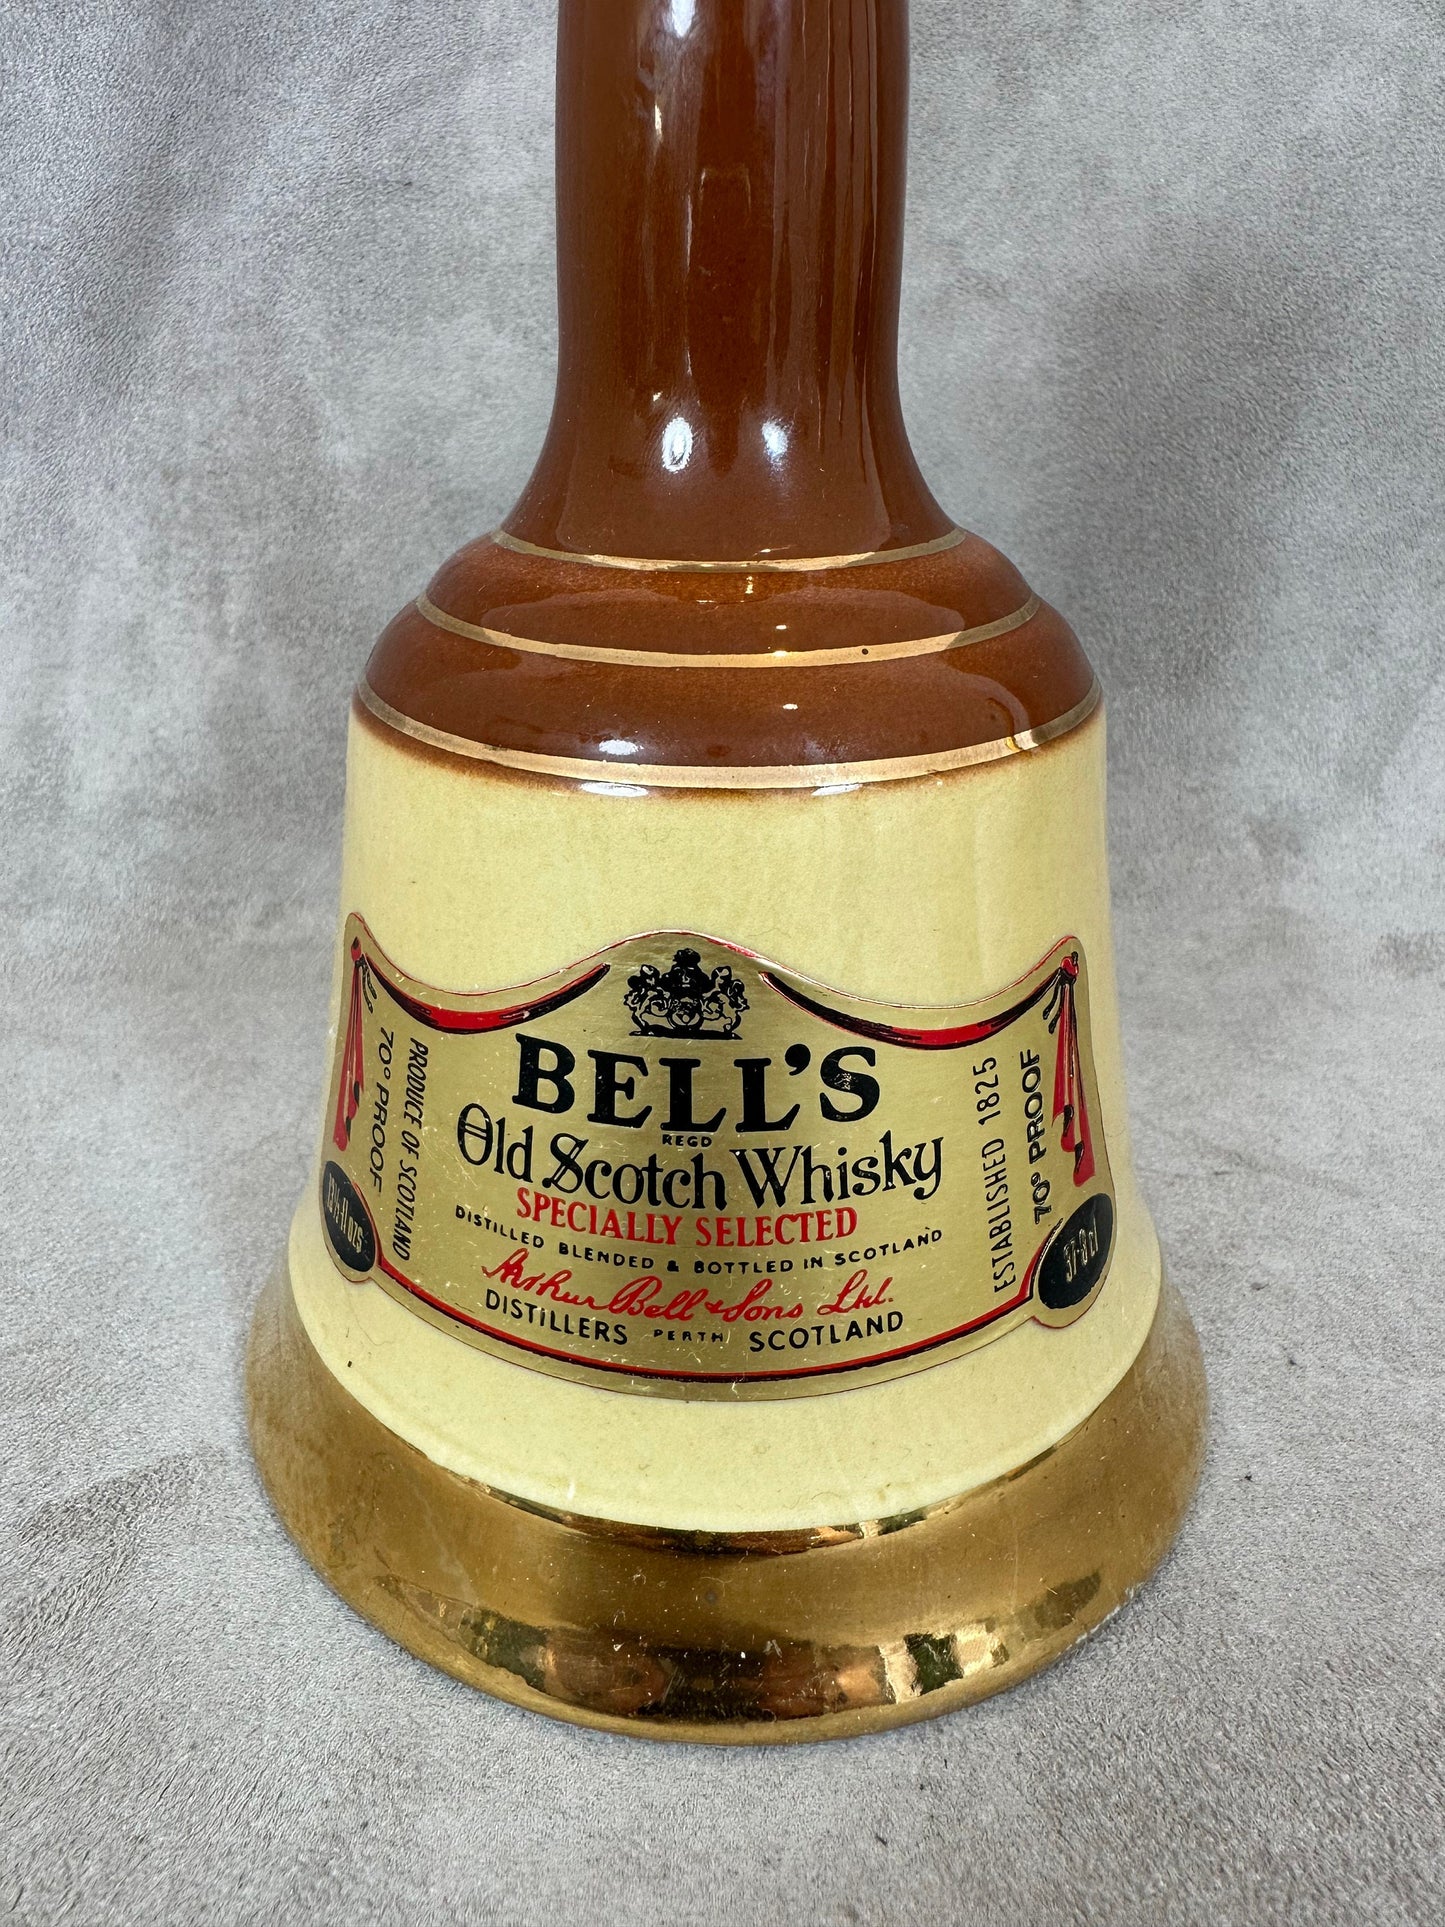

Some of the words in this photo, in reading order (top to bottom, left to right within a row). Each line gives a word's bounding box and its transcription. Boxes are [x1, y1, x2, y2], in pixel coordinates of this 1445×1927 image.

[404, 1037, 429, 1130] PRODUCE
[512, 1032, 881, 1133] BELL'S
[972, 1056, 1000, 1125] 1825
[1020, 1048, 1048, 1163] PROOF
[369, 1082, 390, 1193] PROOF
[400, 1130, 419, 1160] OF
[457, 1103, 534, 1183] Old
[543, 1133, 726, 1211] Scotch
[730, 1130, 944, 1209] Whisky
[662, 1133, 713, 1148] REGD
[392, 1160, 418, 1261] SCOTLAND
[455, 1205, 544, 1248] DISTILLED
[559, 1242, 654, 1269] BLENDED
[666, 1260, 680, 1273] &
[694, 1259, 793, 1275] BOTTLED
[803, 1256, 823, 1270] IN
[834, 1229, 942, 1265] SCOTLAND
[517, 1187, 683, 1246] SPECIALLY
[695, 1206, 858, 1247] SELECTED
[981, 1138, 1016, 1293] ESTABLISHED
[481, 1247, 608, 1311] Arthur
[608, 1275, 709, 1321] Bell
[722, 1278, 803, 1323] Sons
[486, 1288, 628, 1345] DISTILLERS
[653, 1329, 723, 1342] PERTH
[750, 1310, 904, 1352] SCOTLAND
